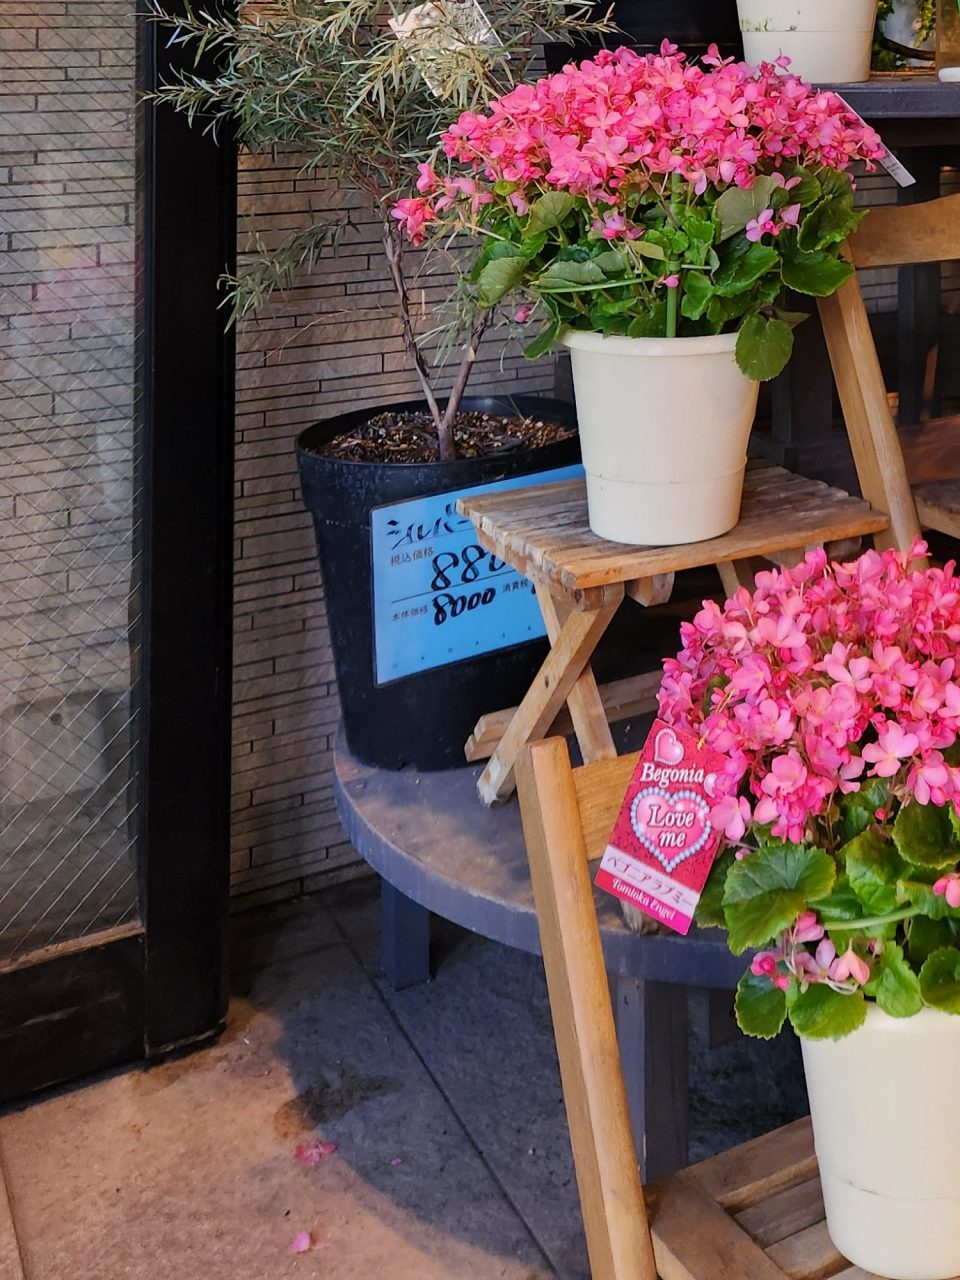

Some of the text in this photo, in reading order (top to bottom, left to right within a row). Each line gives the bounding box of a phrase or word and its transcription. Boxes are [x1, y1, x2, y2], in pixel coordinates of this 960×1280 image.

[431, 587, 497, 626] 8000
[639, 762, 704, 788] Begonia
[647, 804, 695, 828] Love
[657, 830, 687, 848] me
